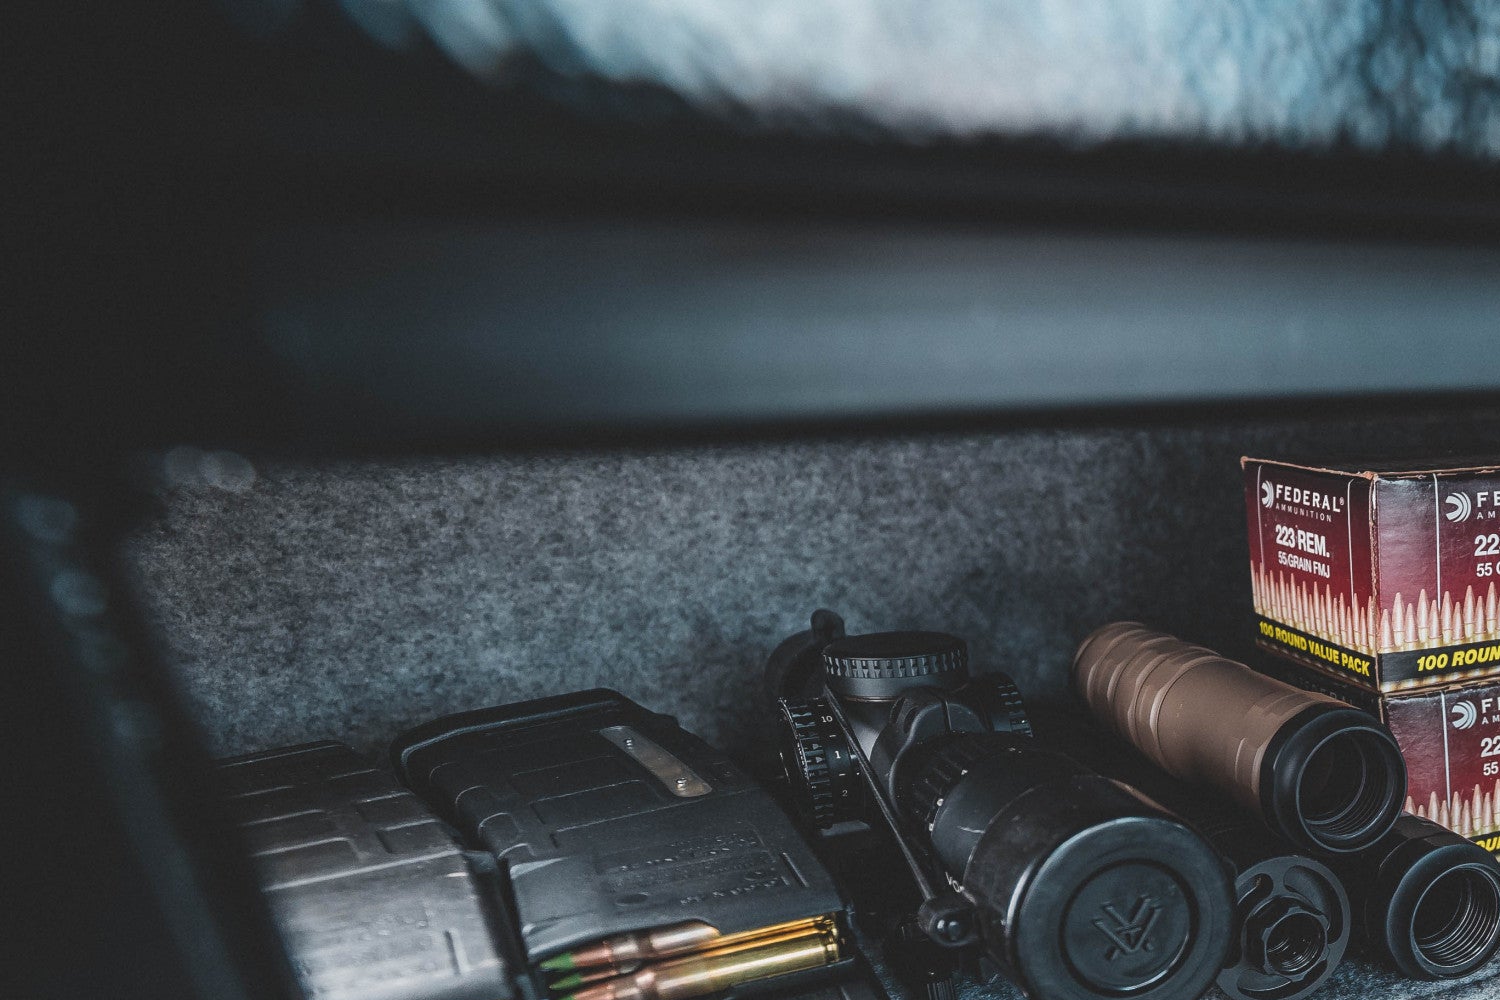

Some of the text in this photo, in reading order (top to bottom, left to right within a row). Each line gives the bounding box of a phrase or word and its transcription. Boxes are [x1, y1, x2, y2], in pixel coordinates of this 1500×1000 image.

[1275, 502, 1332, 522] AMMUNITION
[1275, 524, 1331, 558] 223 REM.
[1278, 551, 1331, 579] 55 GRAIN FMJ
[1476, 562, 1493, 578] 55
[1260, 620, 1370, 677] 100 ROUND VALUE PACK
[1416, 654, 1448, 672] 100
[821, 715, 833, 723] 10
[834, 750, 841, 759] 1
[1483, 762, 1499, 776] 55
